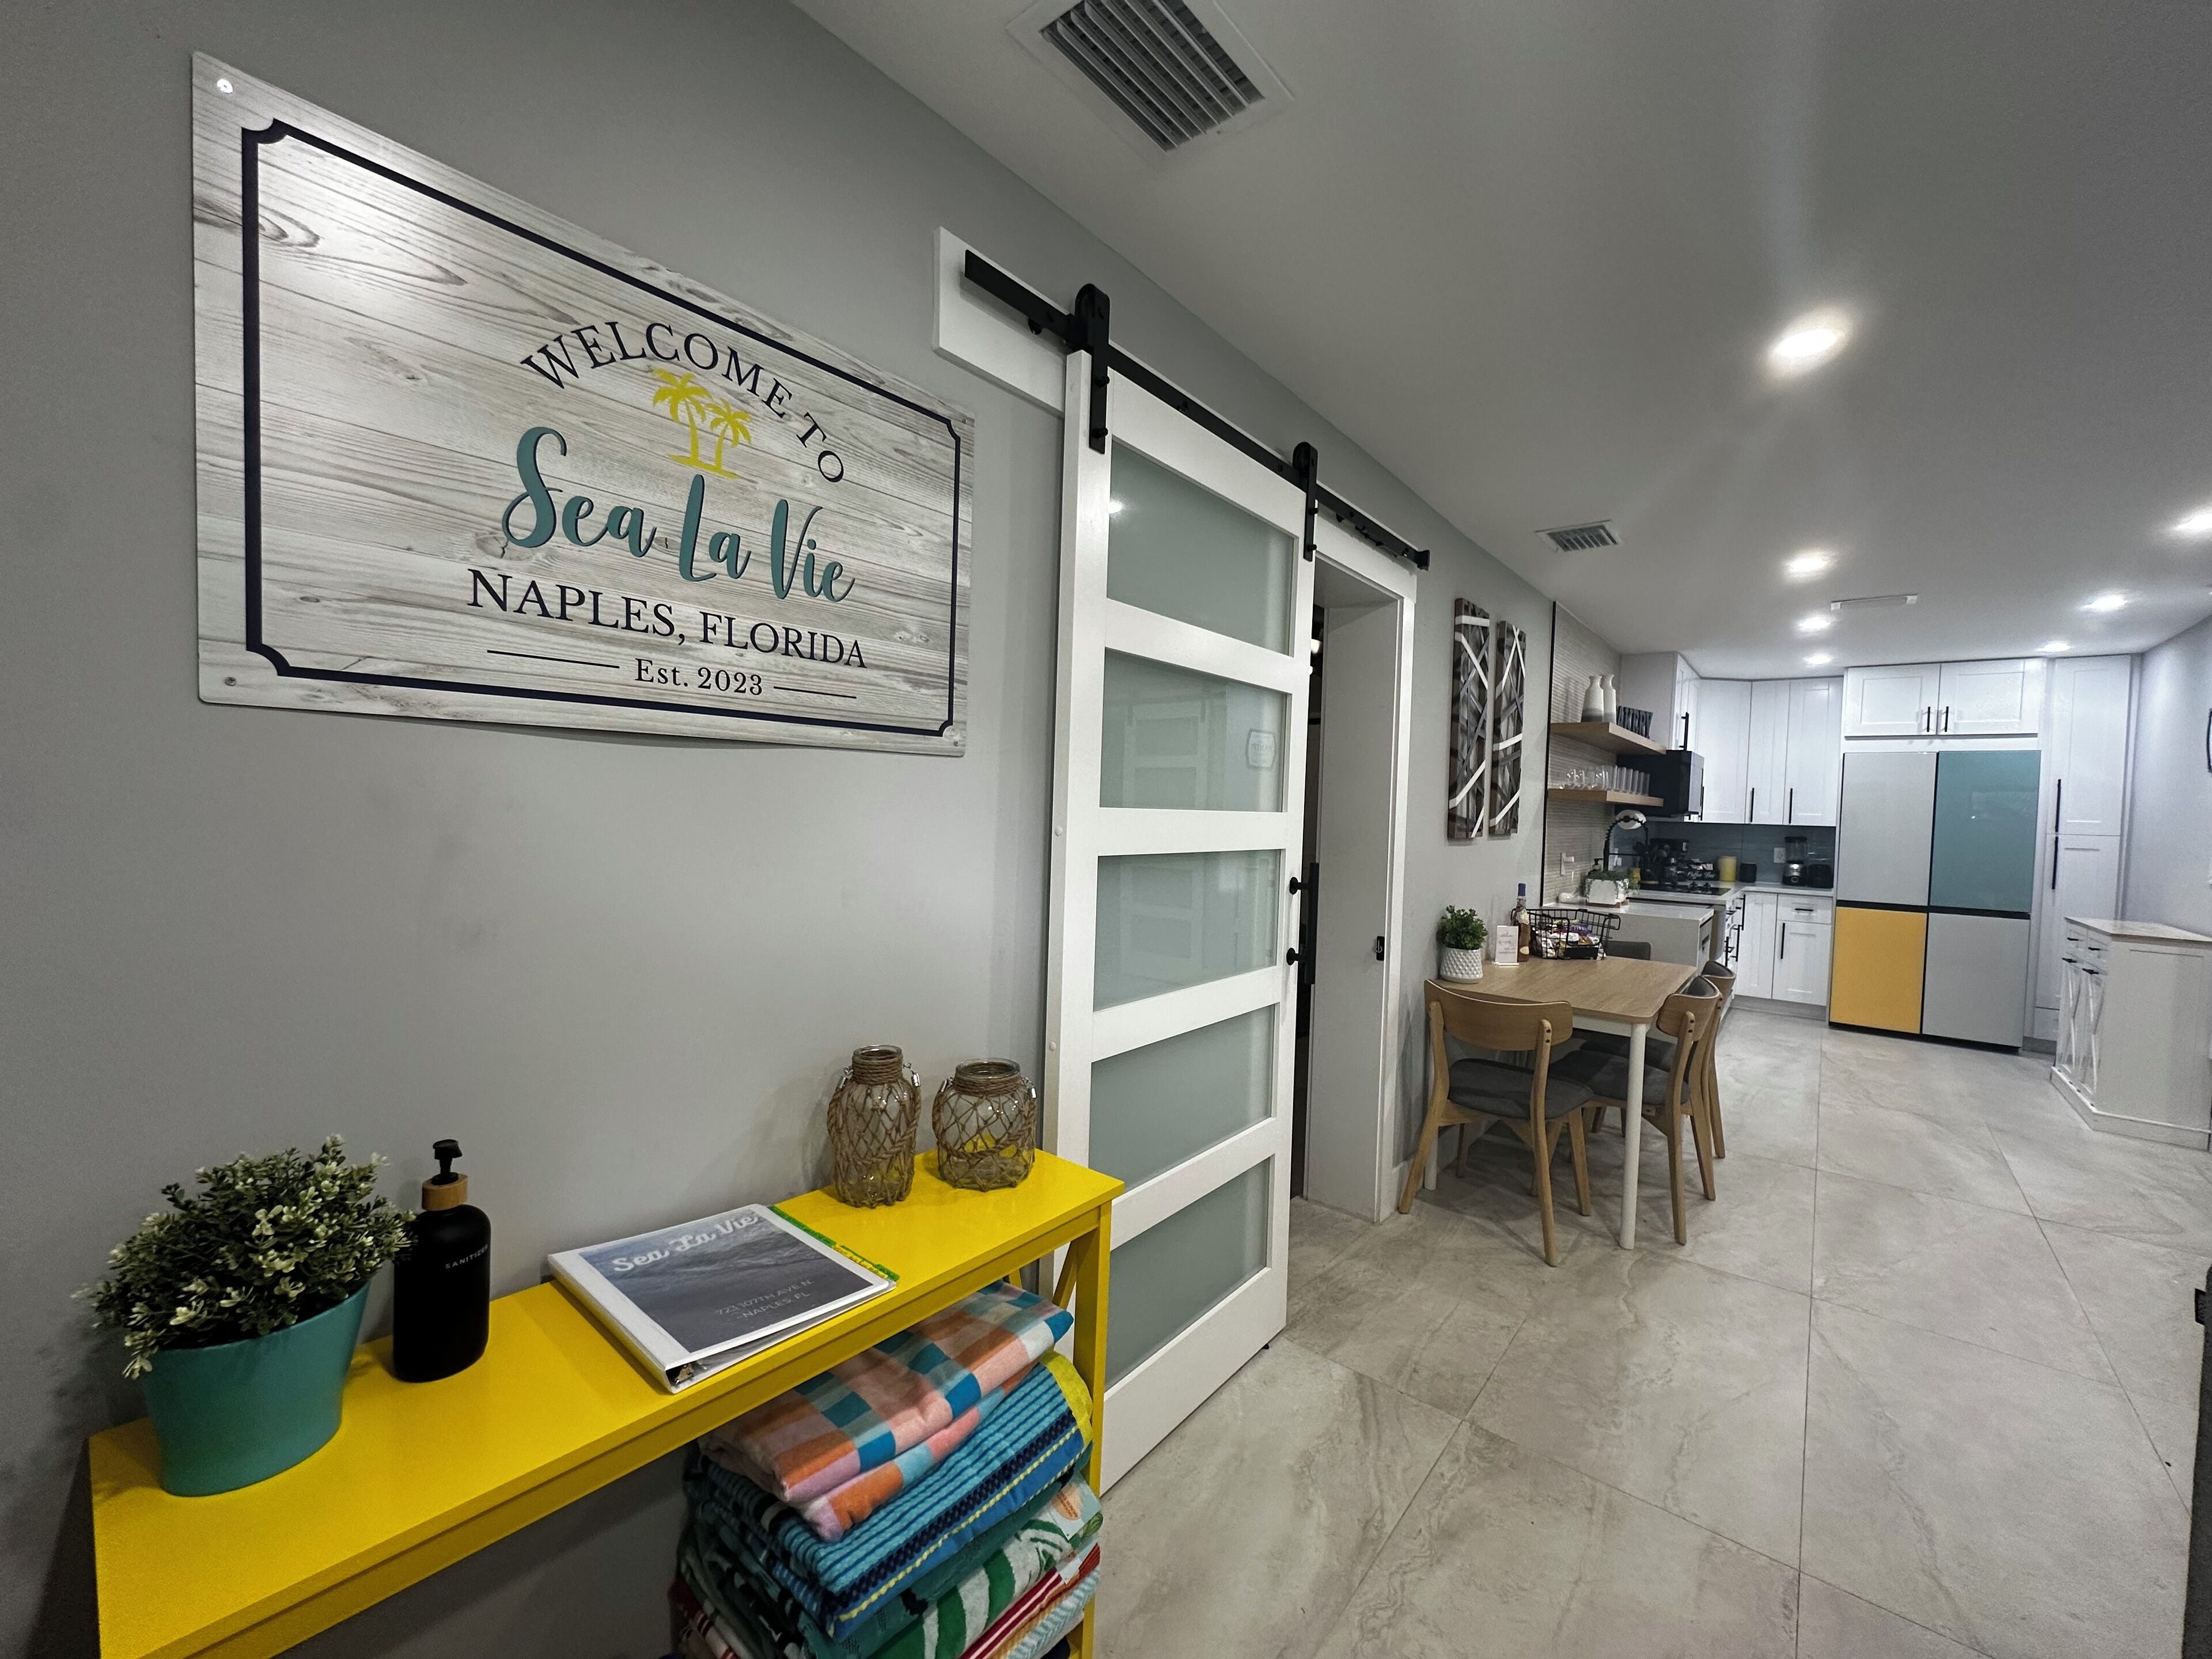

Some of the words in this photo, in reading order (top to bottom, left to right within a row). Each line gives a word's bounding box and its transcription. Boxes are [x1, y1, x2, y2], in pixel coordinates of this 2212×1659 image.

[520, 321, 792, 419] WELCOME
[796, 412, 844, 483] TO
[501, 426, 657, 558] Sea
[678, 474, 752, 582] La
[770, 498, 855, 603] Vie
[467, 569, 685, 645] NAPLES,
[699, 611, 868, 669] FLORIDA
[634, 658, 688, 688] Est.
[697, 668, 763, 696] 2023
[1617, 706, 1653, 740] AKERY
[612, 1249, 669, 1271] Sea
[715, 1215, 759, 1234] Vie
[715, 1305, 738, 1315] 723
[738, 1293, 775, 1307] 107TH
[778, 1284, 801, 1296] AVE
